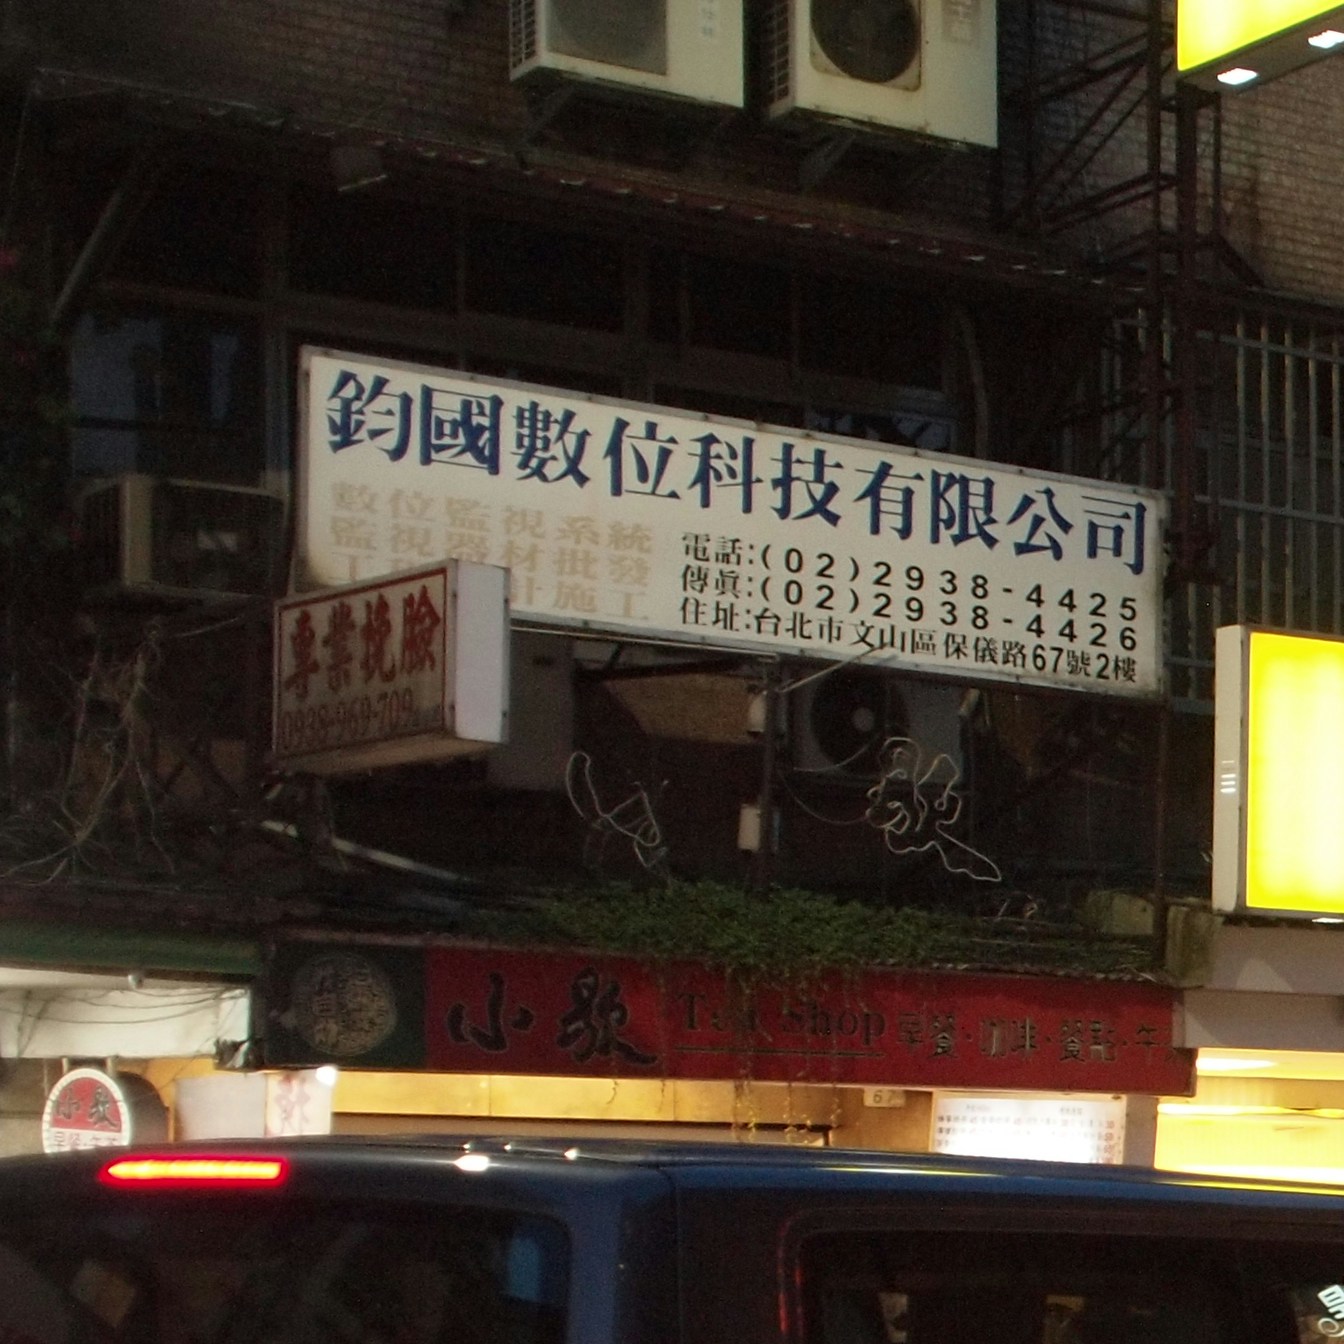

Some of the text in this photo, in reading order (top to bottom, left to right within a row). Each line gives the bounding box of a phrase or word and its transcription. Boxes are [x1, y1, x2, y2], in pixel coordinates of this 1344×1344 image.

[325, 370, 1147, 577] 鈞國數位科技有限公司
